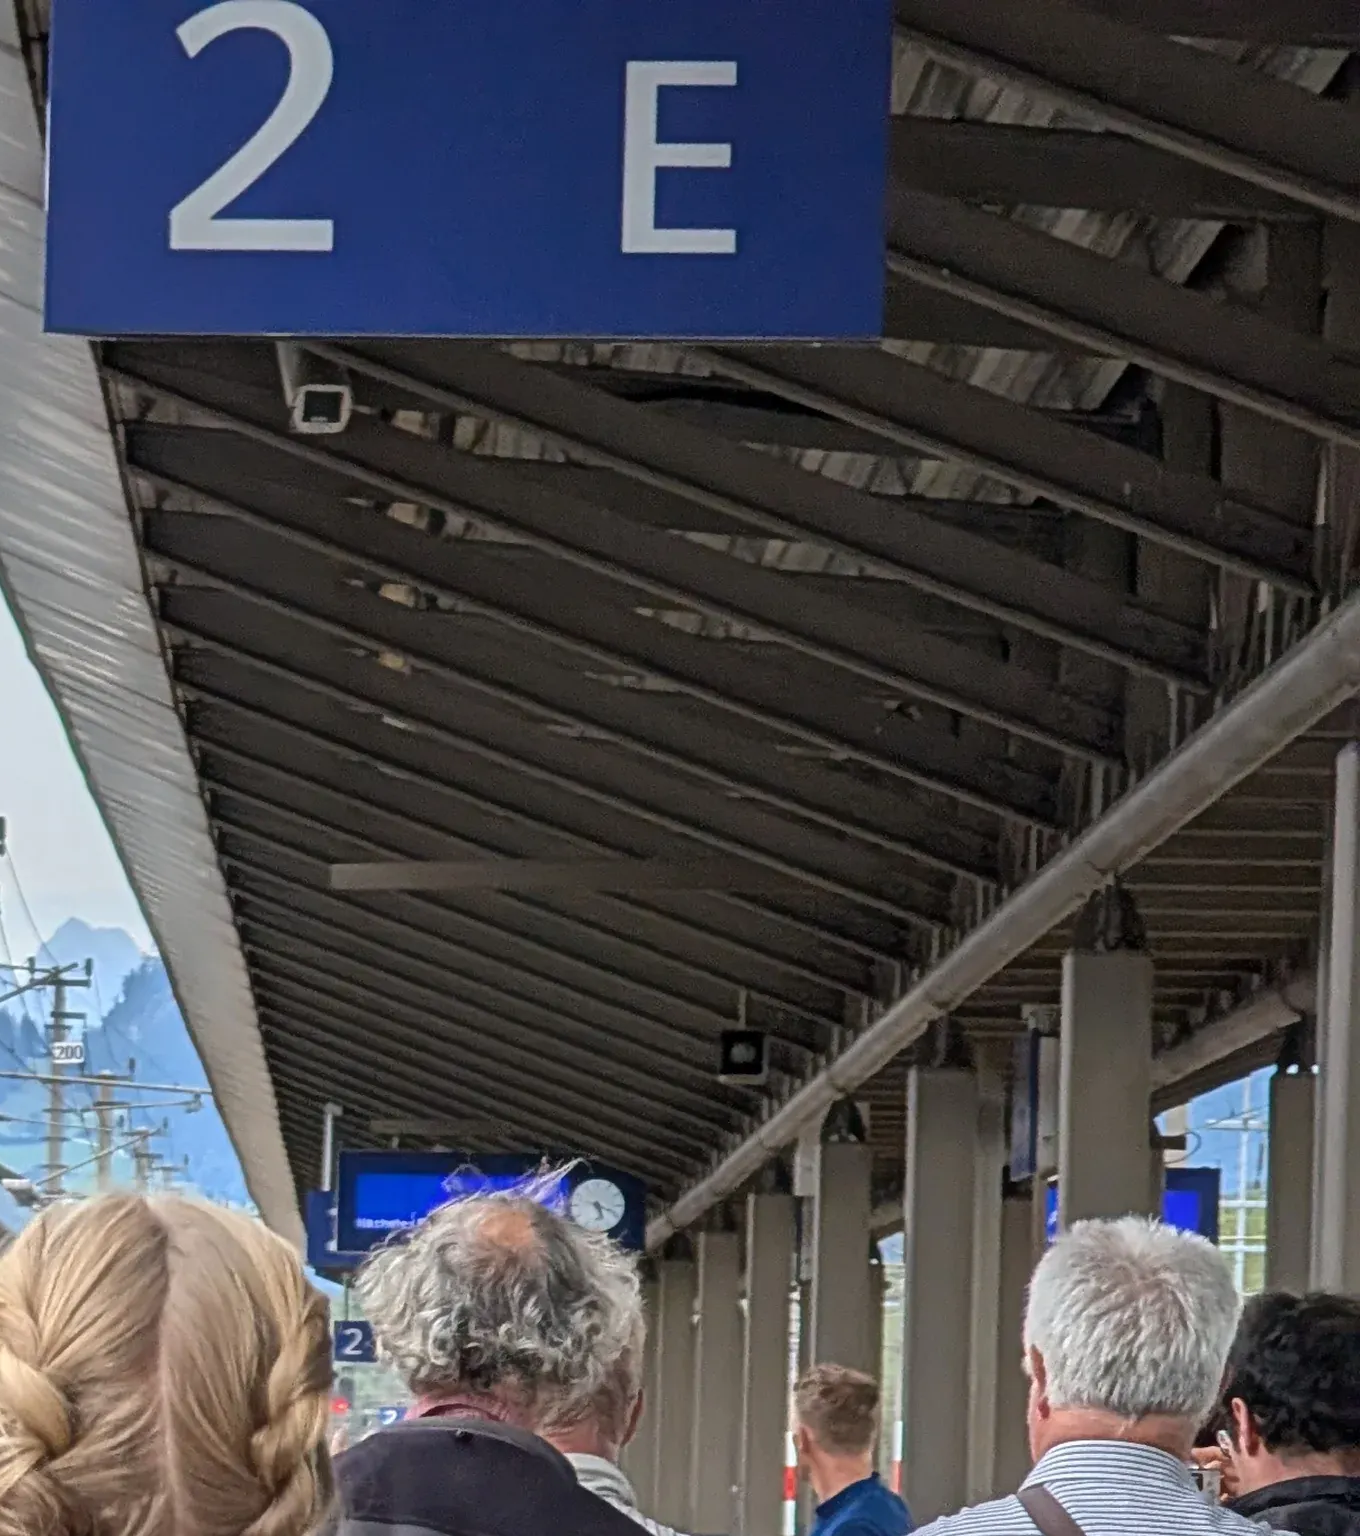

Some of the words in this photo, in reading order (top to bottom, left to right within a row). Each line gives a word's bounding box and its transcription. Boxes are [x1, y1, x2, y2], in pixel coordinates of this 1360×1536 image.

[167, 0, 335, 252] 2
[620, 60, 739, 254] E
[343, 1327, 363, 1355] 2
